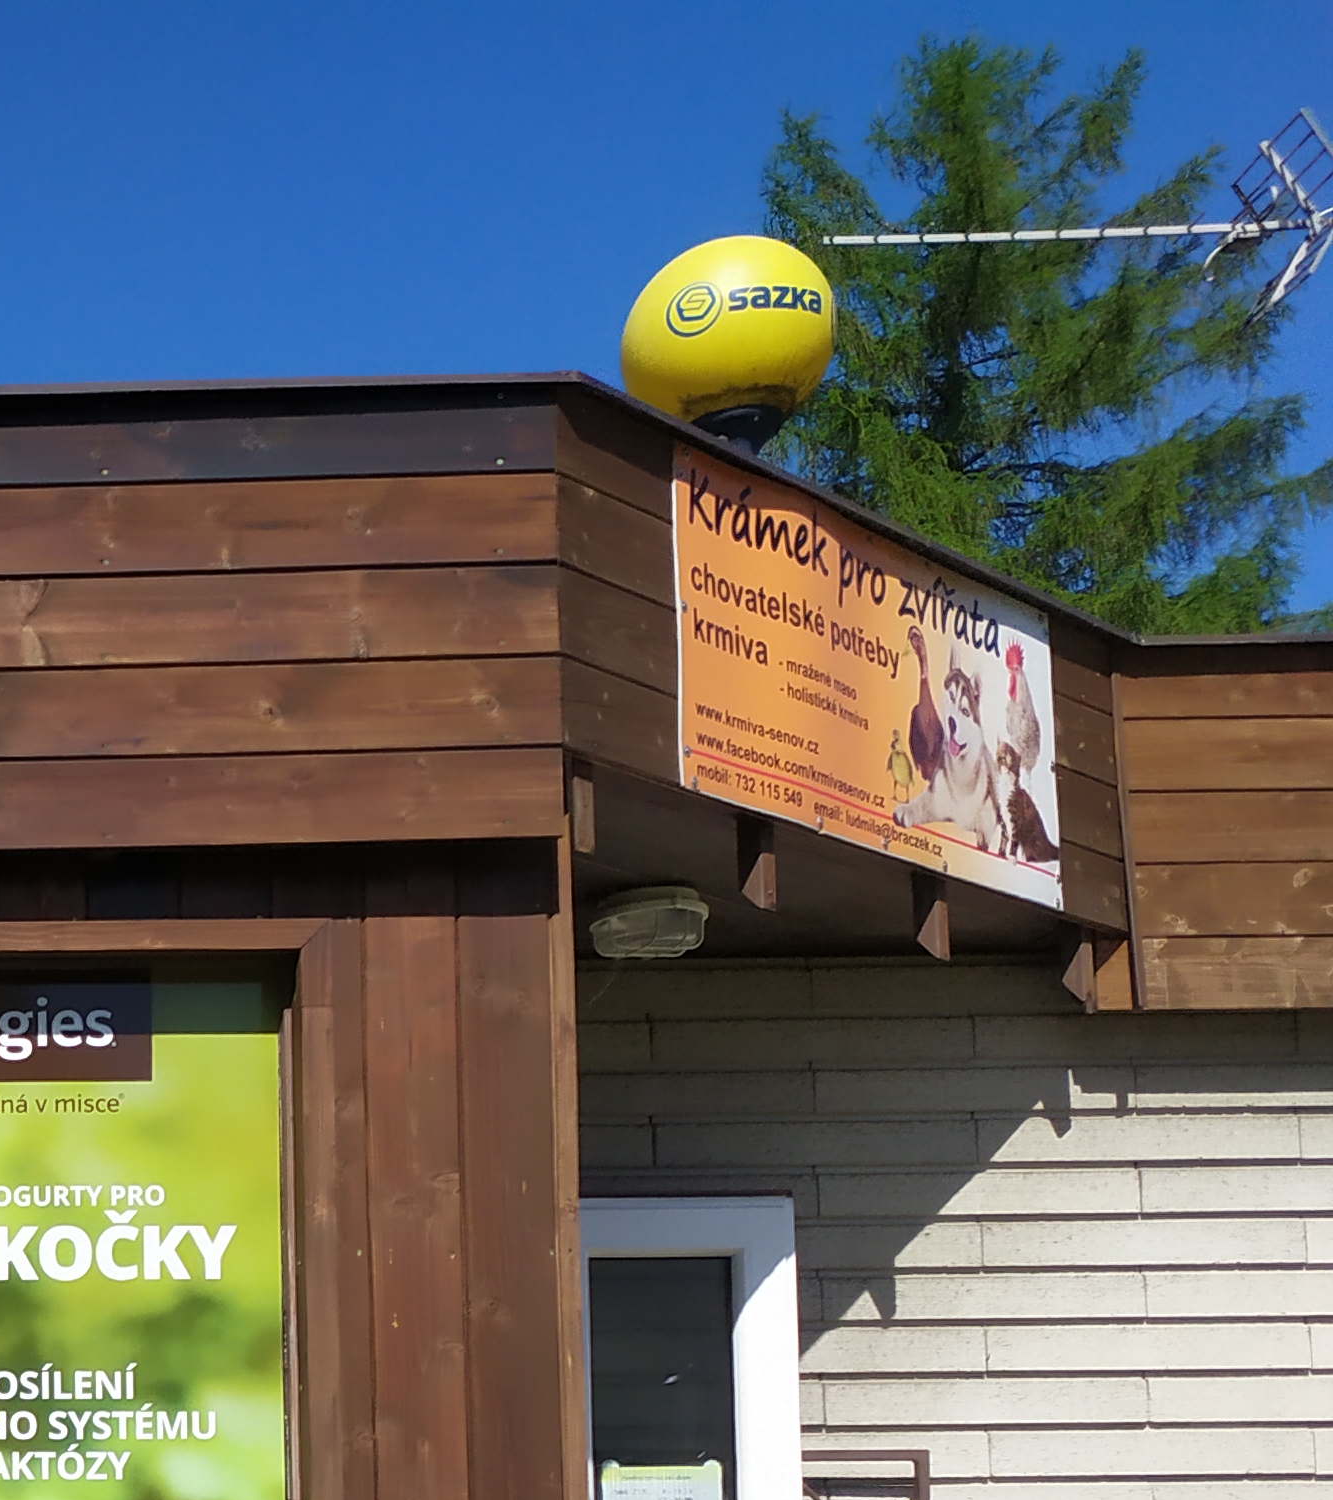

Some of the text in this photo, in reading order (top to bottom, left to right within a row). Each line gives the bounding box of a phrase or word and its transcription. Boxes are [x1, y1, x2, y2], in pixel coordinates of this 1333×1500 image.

[689, 468, 1000, 658] Krámek pro zvířata
[691, 562, 899, 680] chovatelské potřeby
[694, 608, 768, 666] krmiva
[786, 658, 857, 700] mražené maso
[695, 701, 819, 755] www.krmiva-senov.cz
[787, 682, 869, 730] holistické krmiva
[697, 763, 731, 785] mobil:
[735, 773, 755, 794] 732
[759, 780, 780, 799] 115
[783, 787, 803, 807] 549
[813, 800, 843, 822] email:
[35, 1098, 48, 1113] v
[54, 1094, 120, 1113] misce
[110, 1185, 165, 1207] PRO
[48, 1404, 217, 1440] SYSTÉMU
